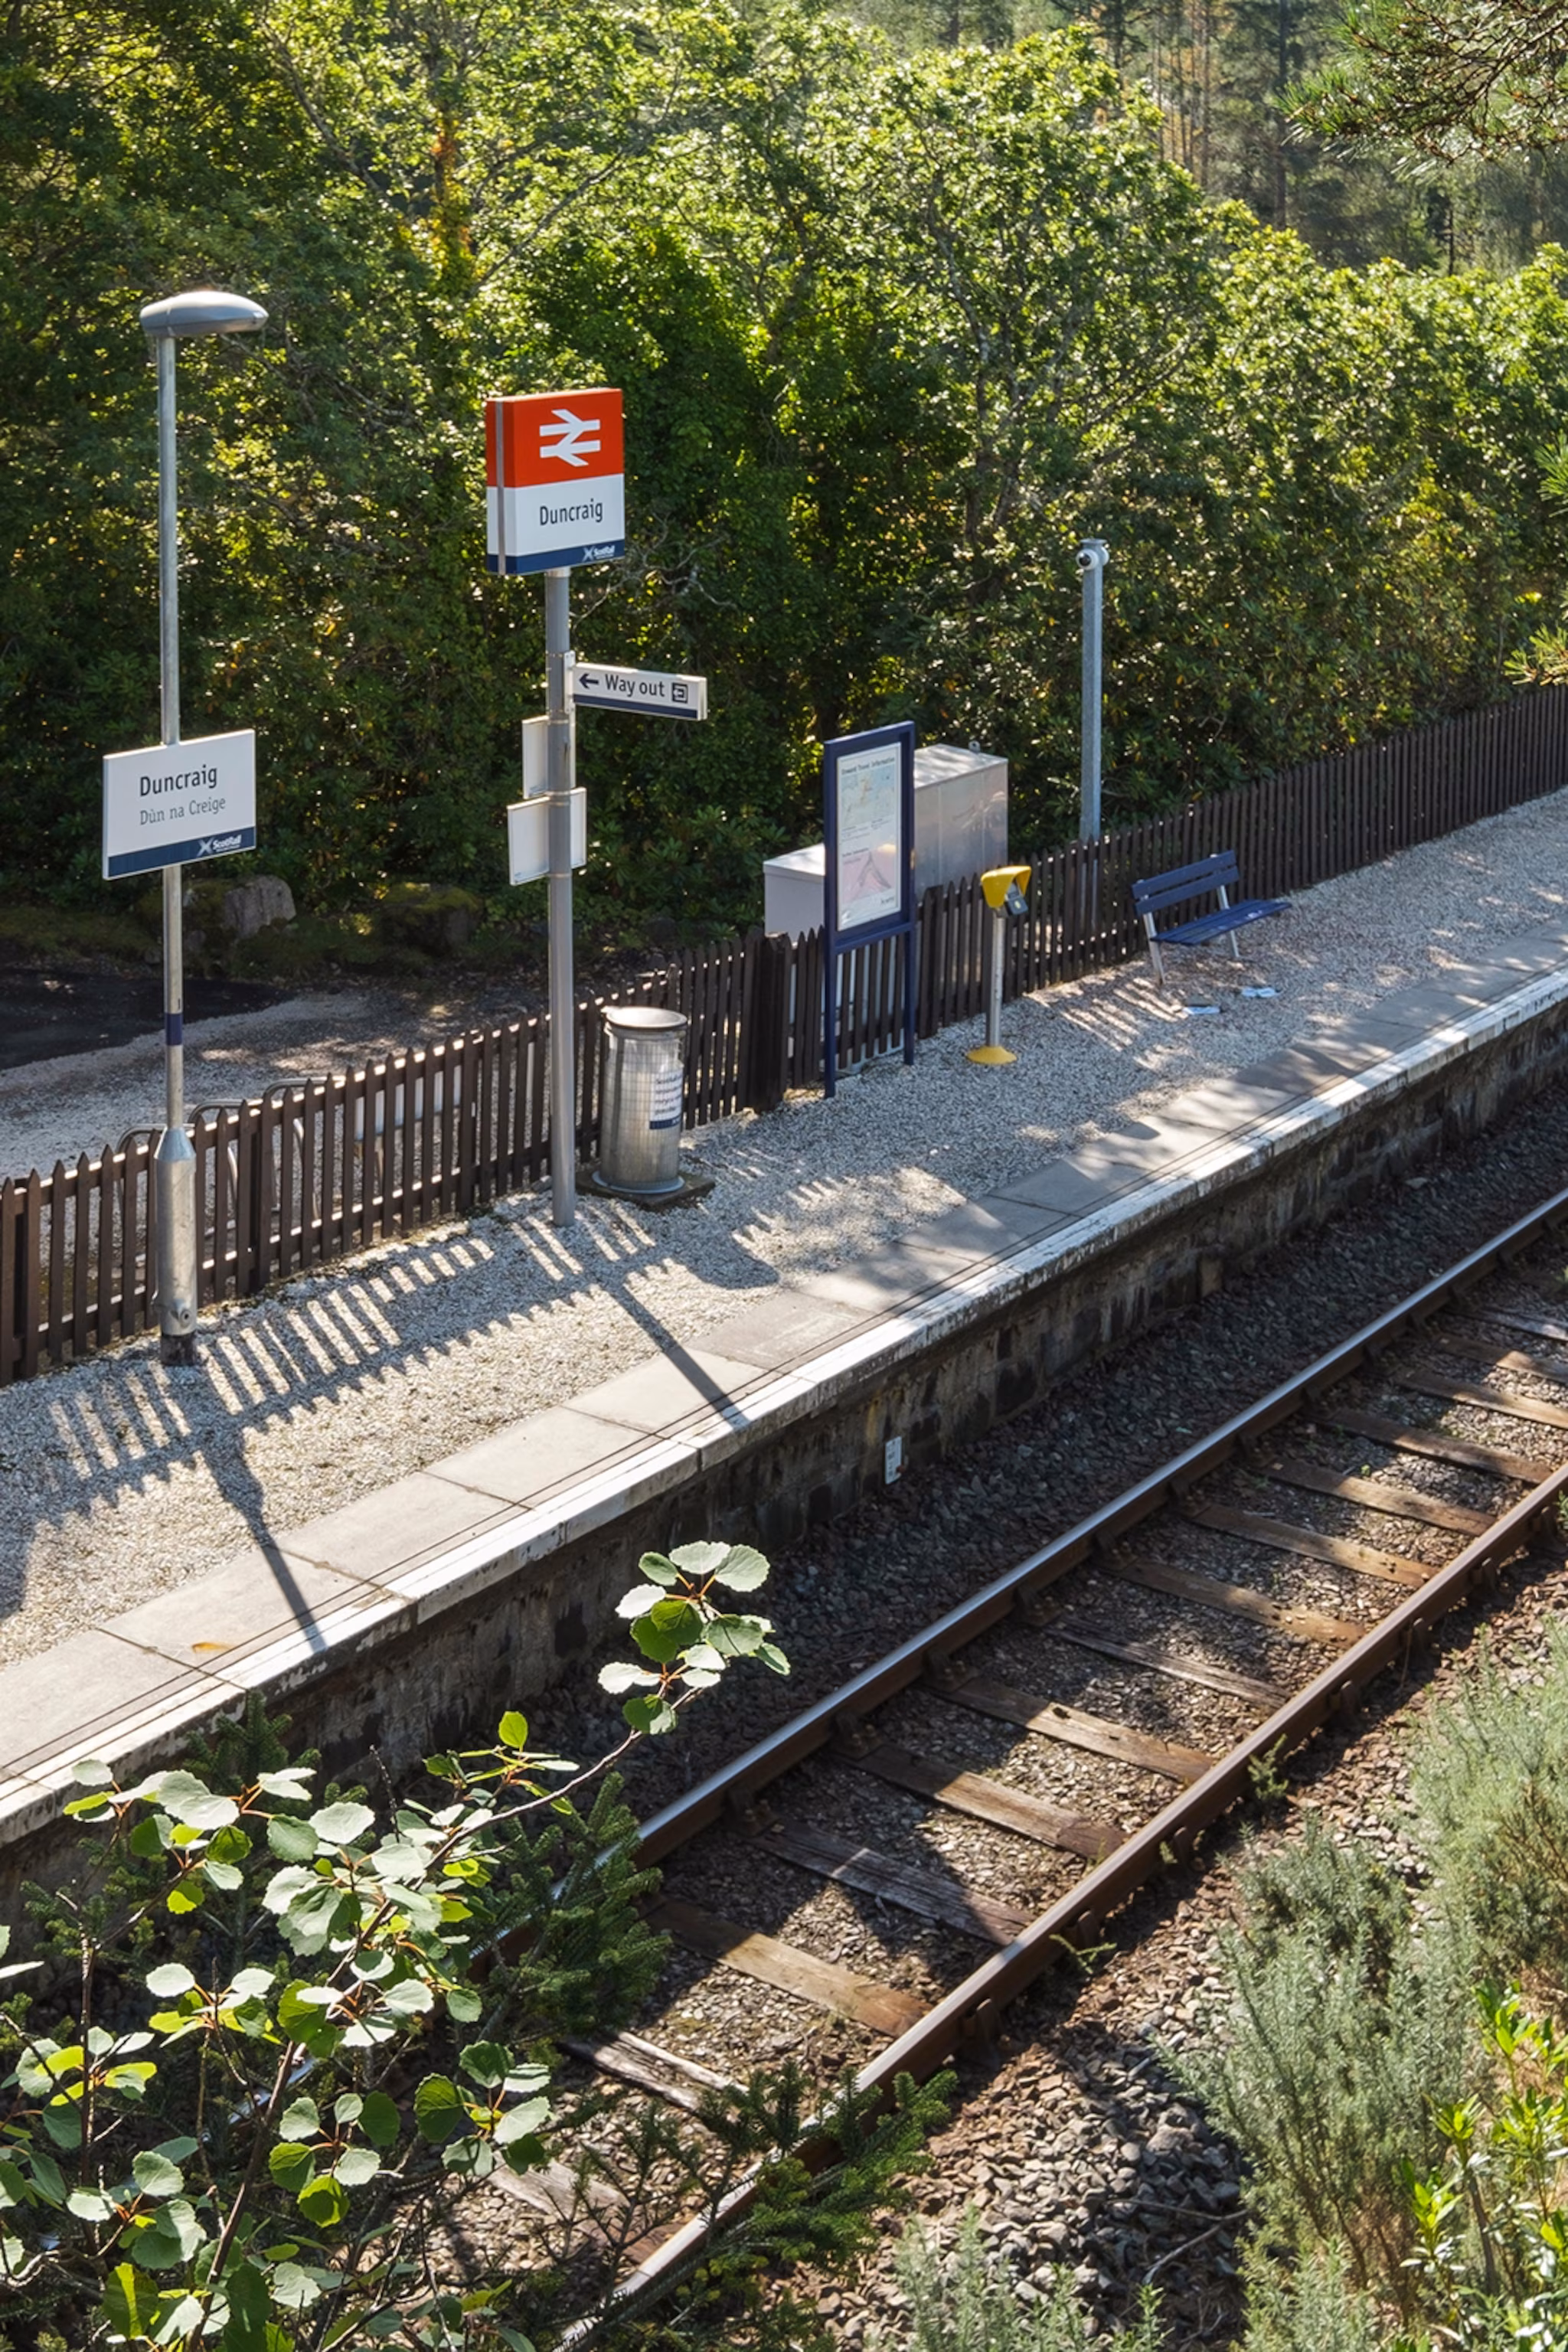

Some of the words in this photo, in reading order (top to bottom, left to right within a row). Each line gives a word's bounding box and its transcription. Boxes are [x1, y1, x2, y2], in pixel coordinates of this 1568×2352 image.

[539, 498, 603, 526] Duncraig
[605, 673, 635, 697] Way
[639, 681, 665, 697] out
[139, 764, 217, 797] Duncraig
[139, 808, 165, 825] Dùn
[169, 806, 185, 820] na
[188, 796, 226, 815] Creige
